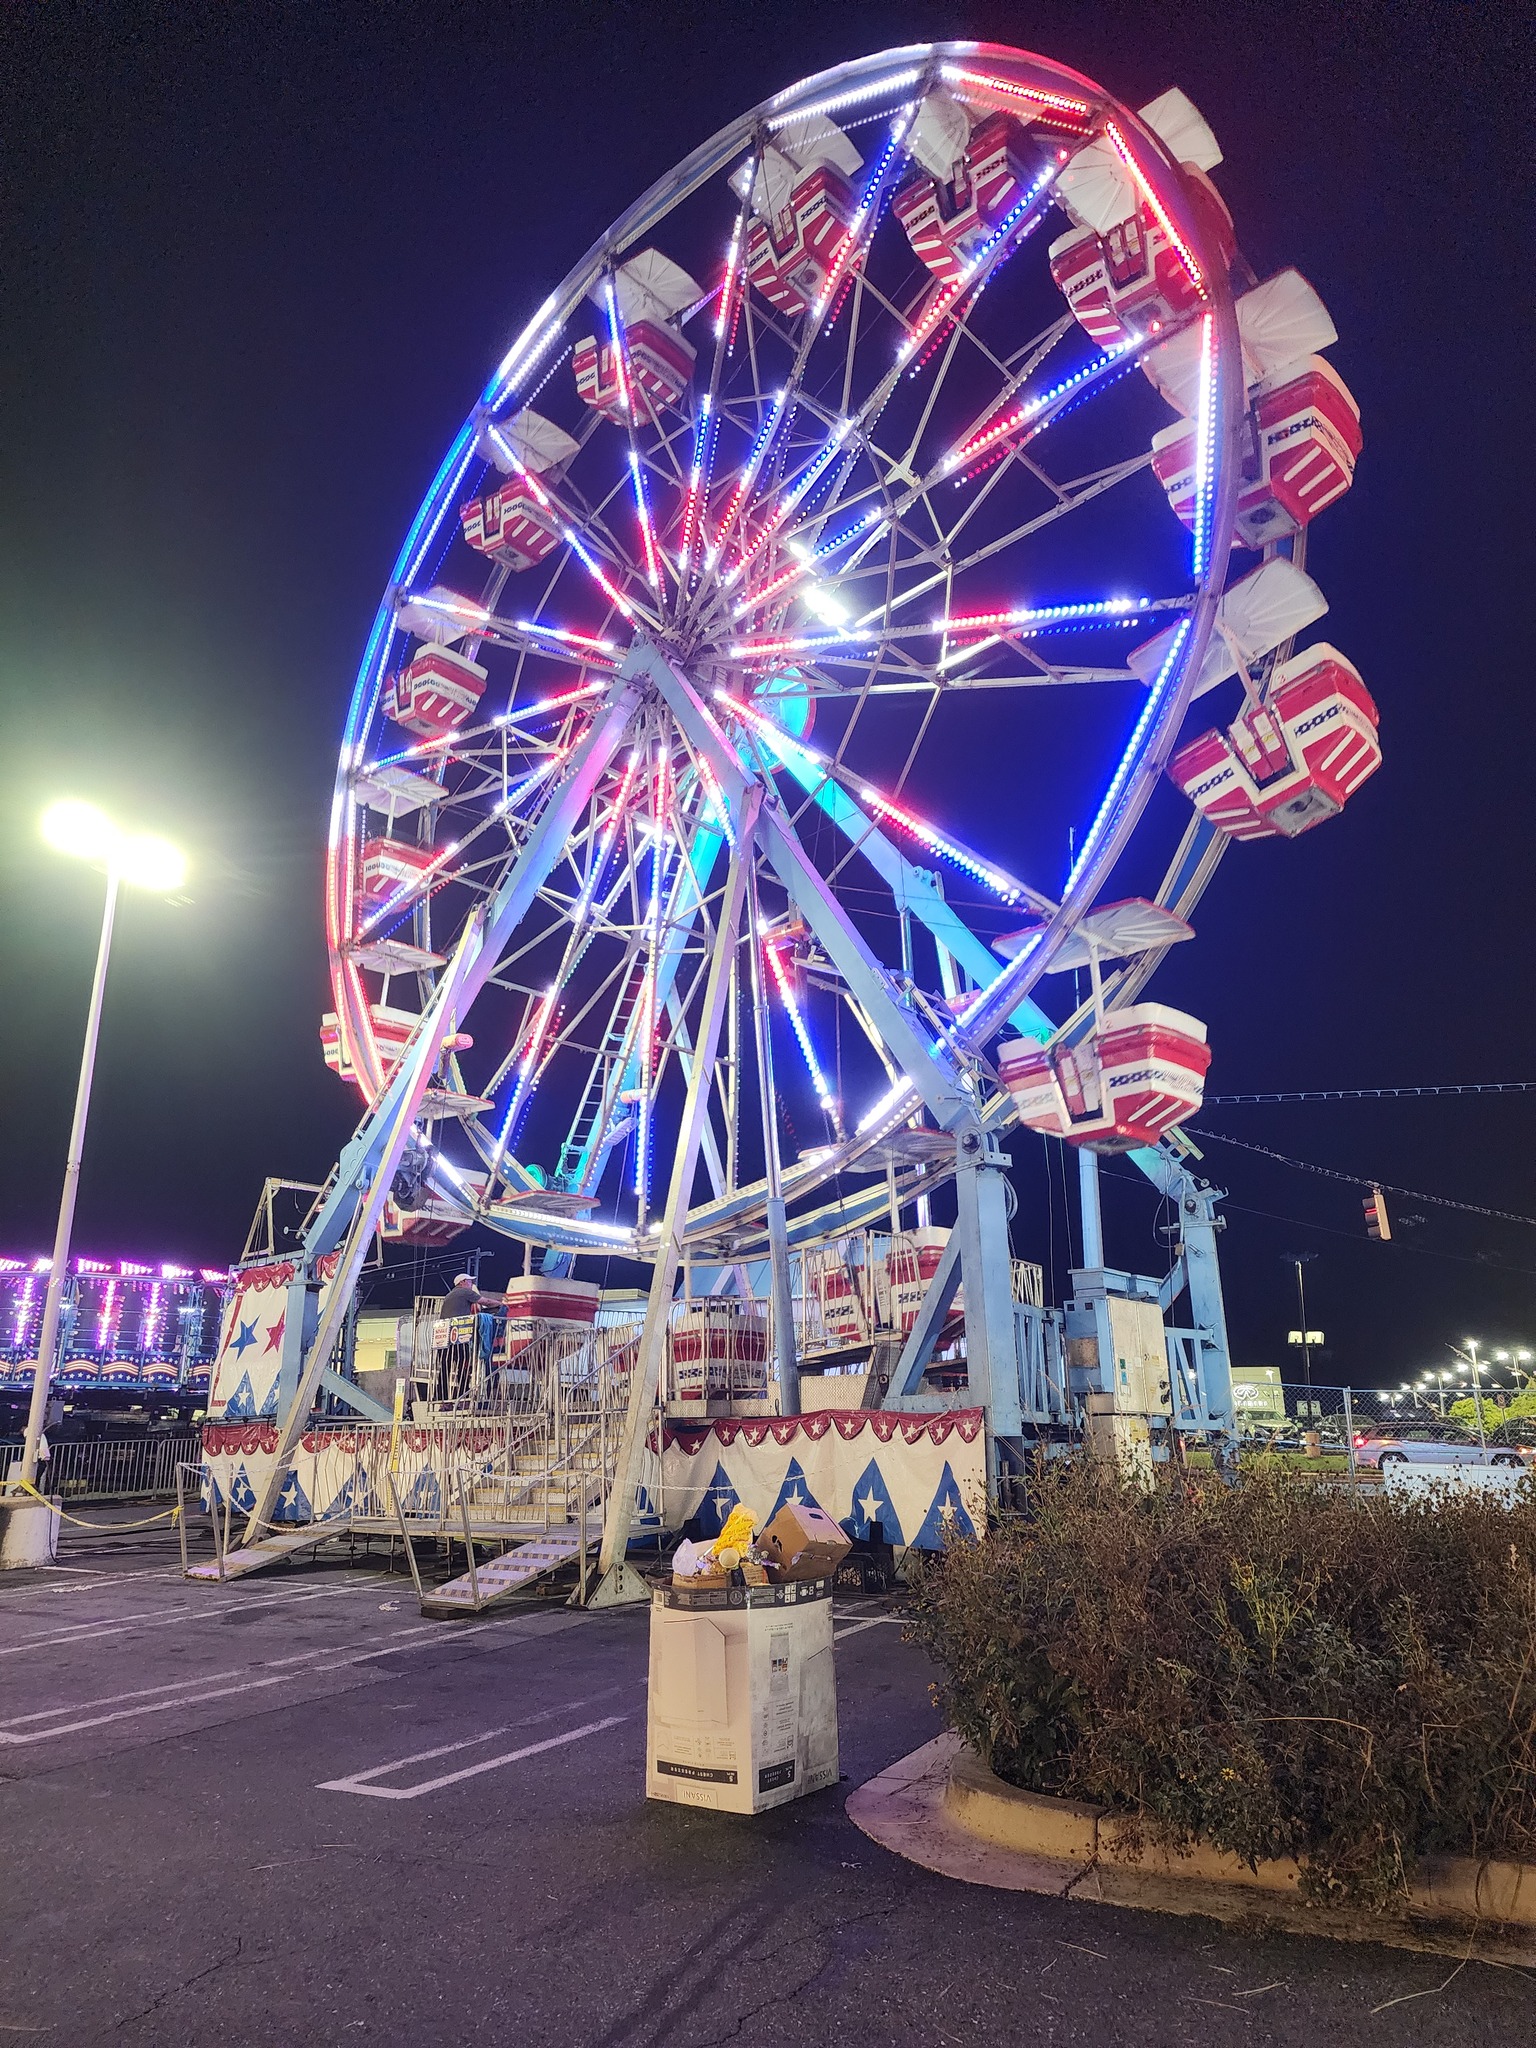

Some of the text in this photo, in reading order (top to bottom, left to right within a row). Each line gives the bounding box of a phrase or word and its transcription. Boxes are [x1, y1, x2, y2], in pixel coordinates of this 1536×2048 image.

[451, 1328, 458, 1342] 6
[670, 1766, 714, 1778] CHEST FREEZER
[682, 1789, 712, 1802] VISSANI
